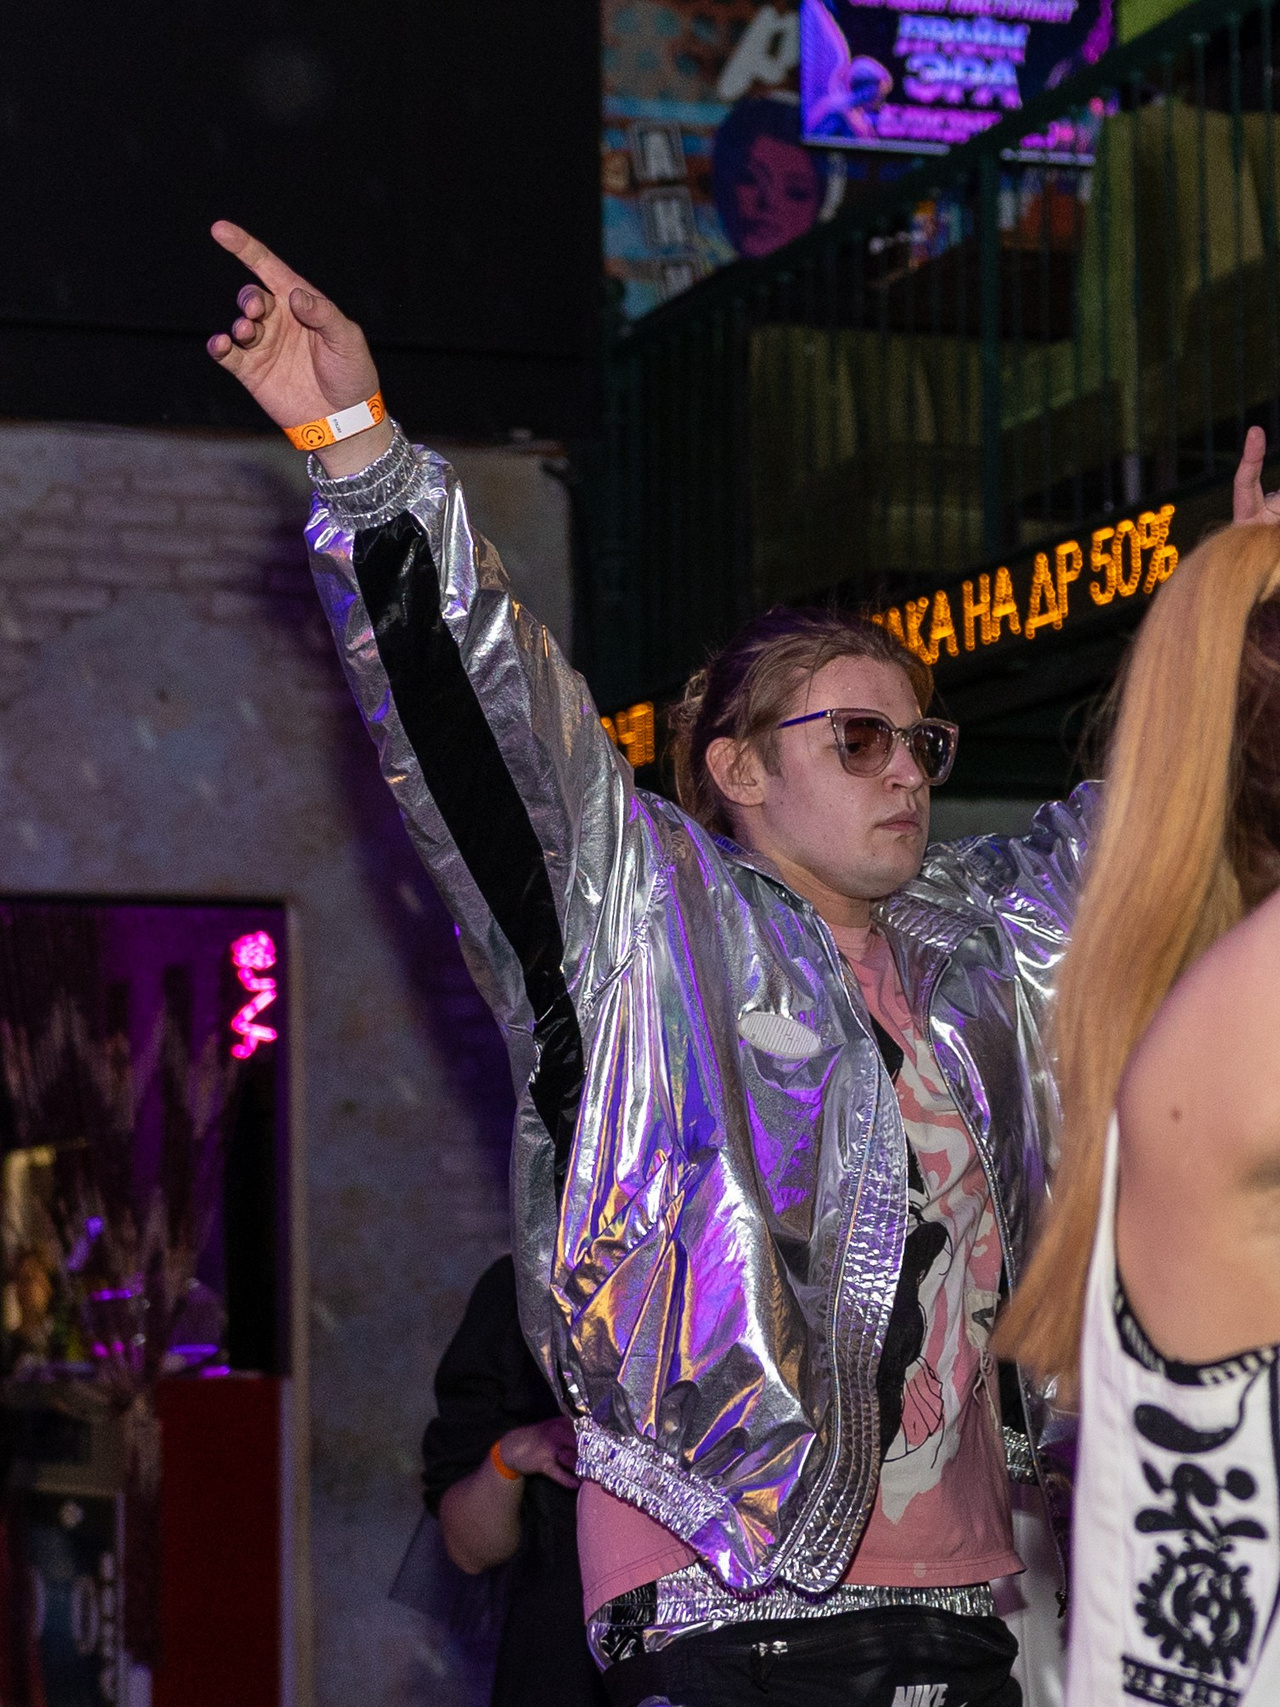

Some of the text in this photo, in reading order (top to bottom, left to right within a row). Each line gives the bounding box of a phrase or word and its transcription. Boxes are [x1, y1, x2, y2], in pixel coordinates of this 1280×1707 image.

[962, 566, 1022, 651] НА
[1025, 540, 1084, 640] ДР
[1089, 503, 1180, 606] 50%
[891, 1683, 949, 1707] NIKE
